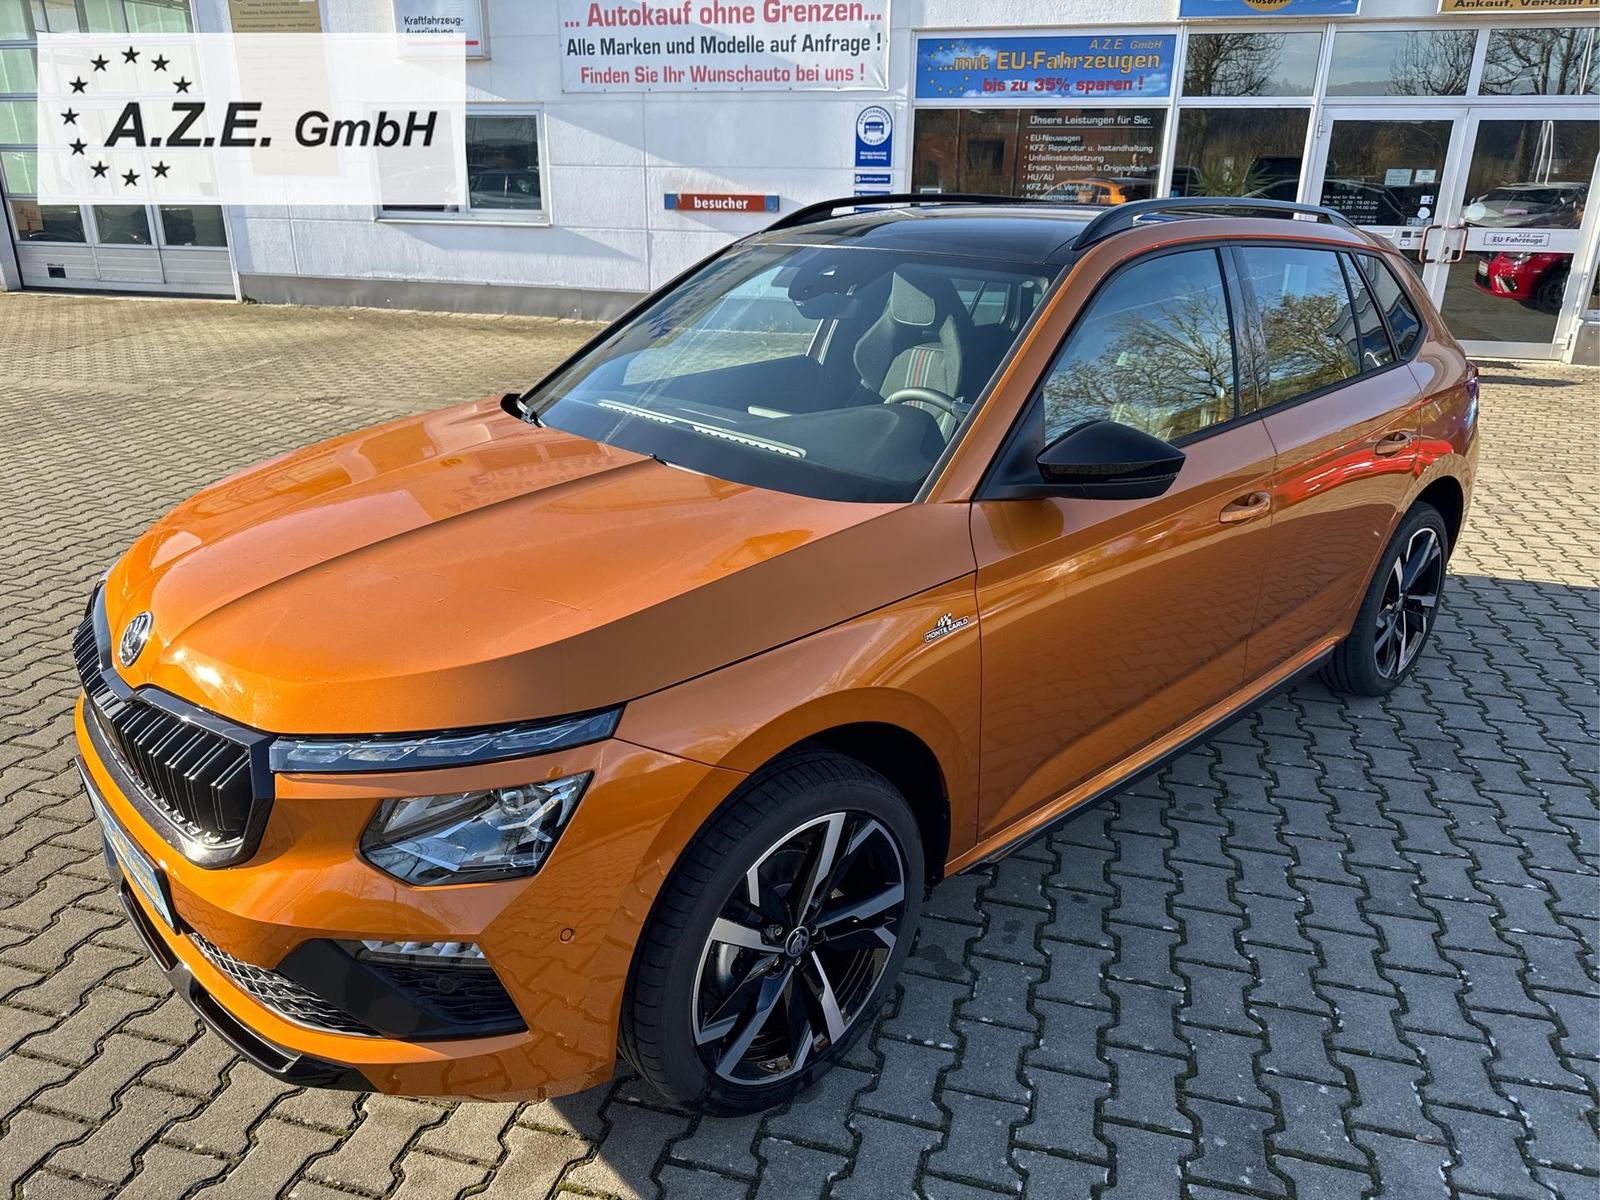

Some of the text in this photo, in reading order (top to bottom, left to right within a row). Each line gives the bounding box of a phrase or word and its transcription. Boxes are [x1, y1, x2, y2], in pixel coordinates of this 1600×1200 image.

[587, 1, 692, 27] Autokauf
[699, 0, 755, 24] ohne
[763, 0, 882, 23] Grenzen...
[403, 16, 464, 26] Kraftfahrzeug-
[566, 38, 595, 56] Alle
[600, 37, 661, 56] Marken
[666, 36, 695, 54] und
[700, 35, 765, 54] Modelle
[770, 34, 797, 53] auf
[802, 33, 871, 56] Anfrage
[1130, 40, 1163, 50] GmbH
[995, 50, 1161, 74] EU-Fahrzeugen
[580, 66, 630, 84] Finden
[634, 65, 659, 83] Sie
[663, 65, 685, 83] Ihr
[689, 64, 791, 83] Wunschauto
[795, 63, 819, 82] bei
[824, 68, 854, 82] uns
[982, 77, 1006, 92] bis
[1010, 80, 1028, 91] zu
[1034, 77, 1071, 92] 35%
[1076, 79, 1133, 95] sparen
[1030, 115, 1152, 126] Unsere Leistungen für Sie:
[1030, 134, 1081, 143] EU-Neuwagen
[1048, 144, 1085, 153] Reparatur
[1097, 145, 1154, 154] Instandhaltung
[1028, 154, 1105, 163] Unfallinstandsetzung
[1026, 173, 1055, 181] HU/AU
[693, 196, 749, 210] besucher
[926, 618, 968, 641] MONTE CARLO
